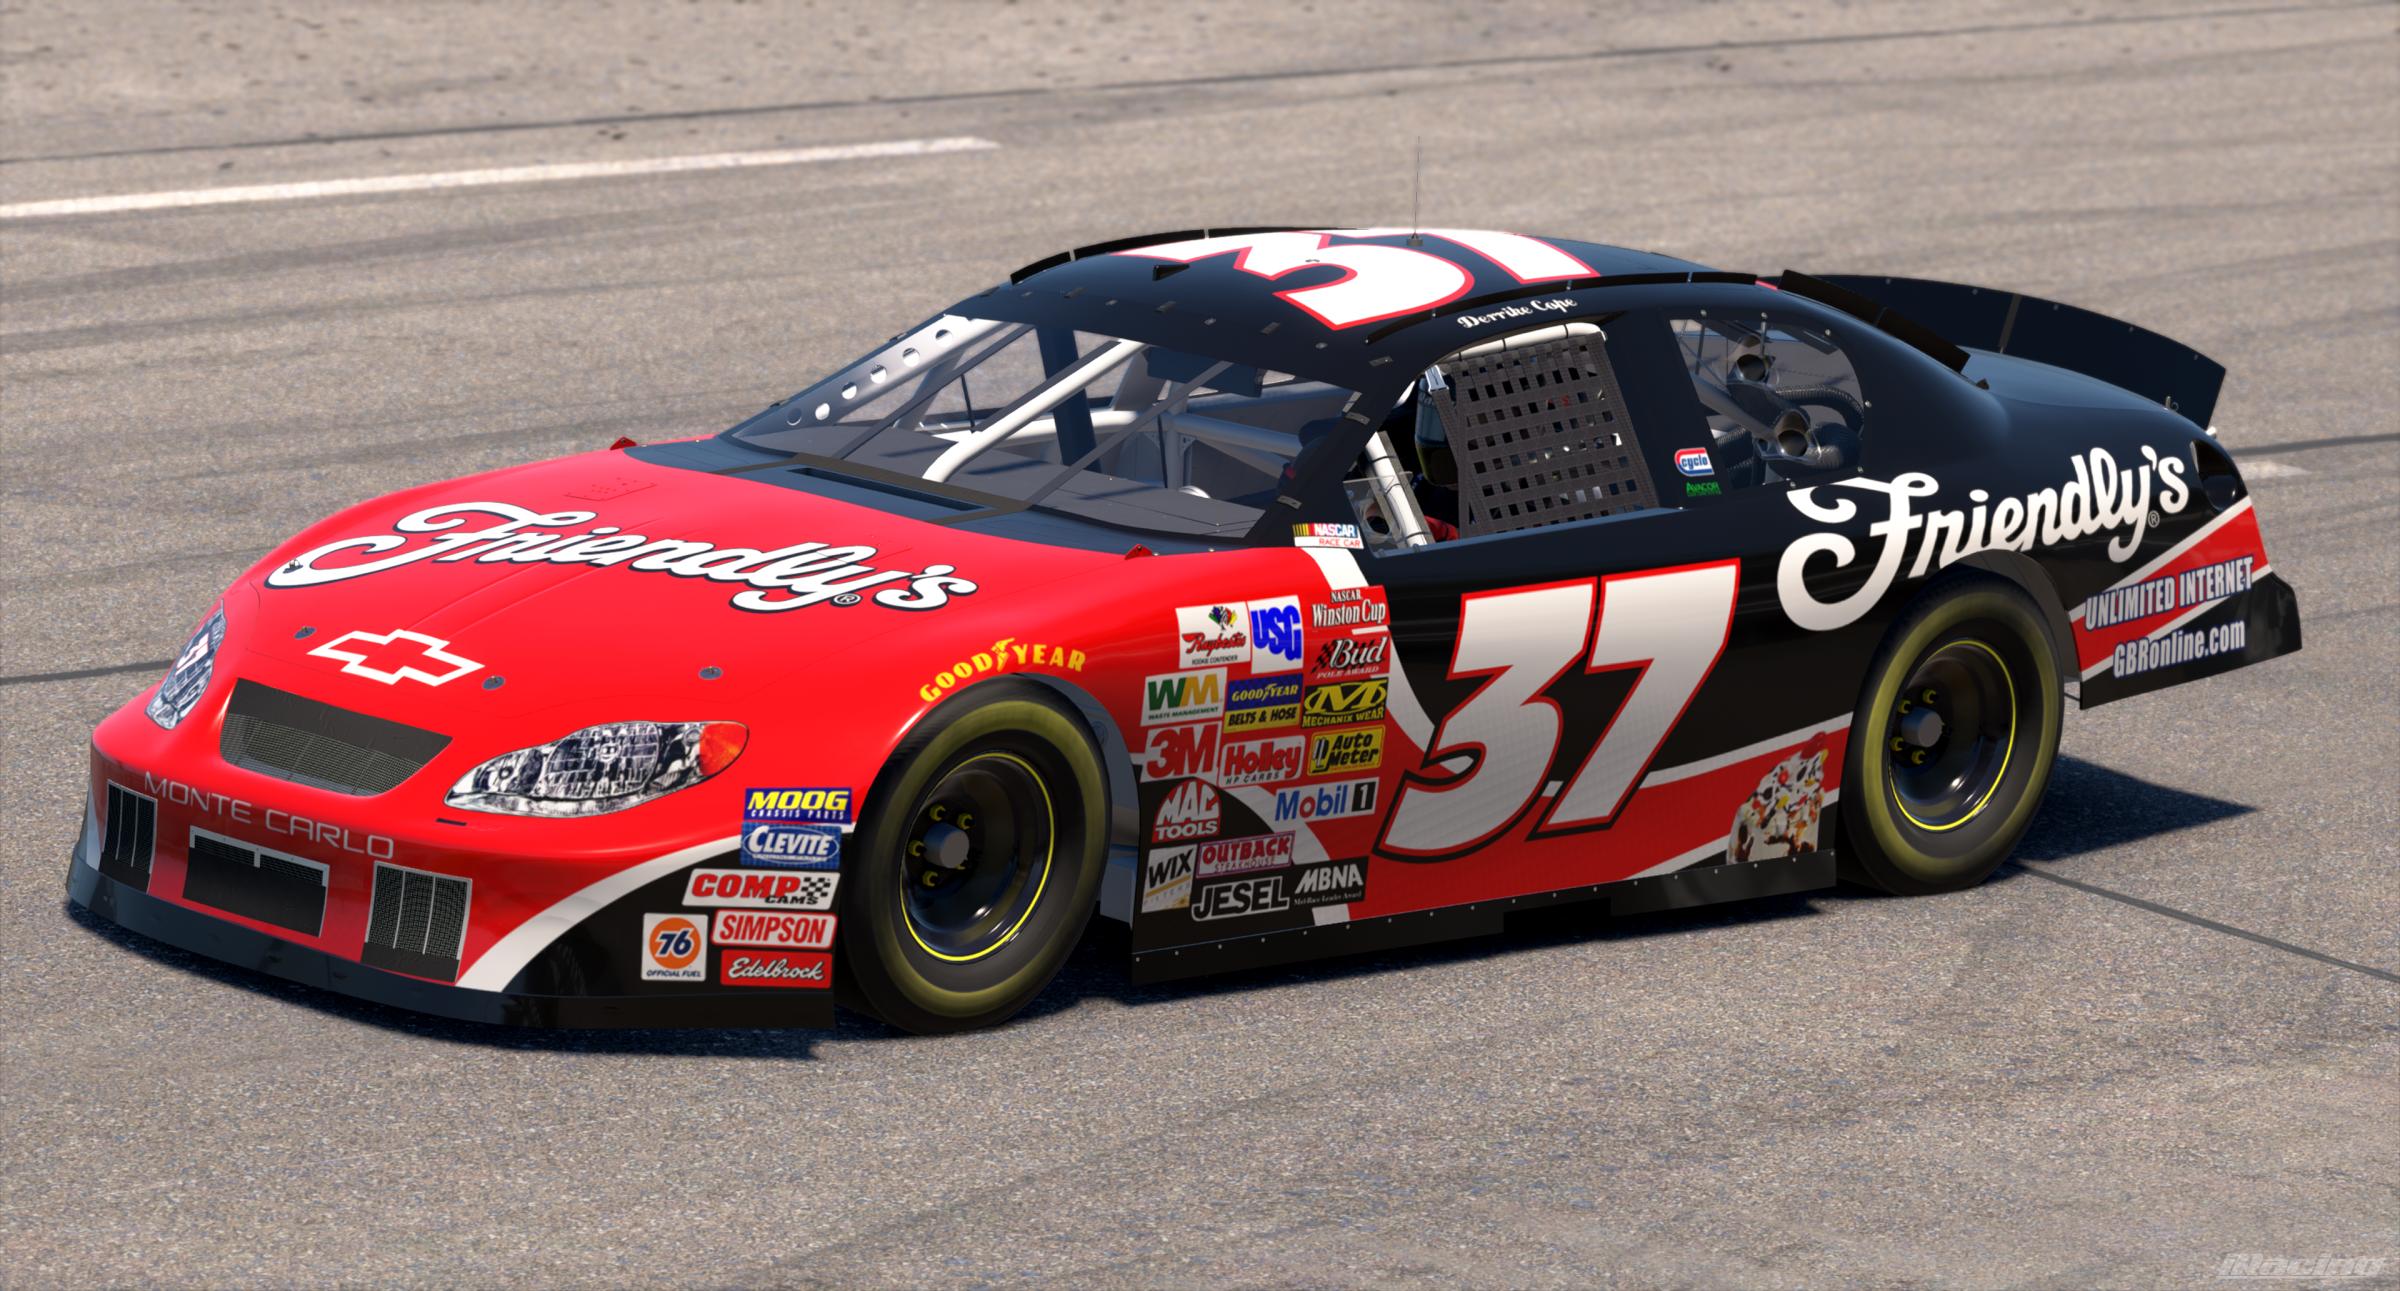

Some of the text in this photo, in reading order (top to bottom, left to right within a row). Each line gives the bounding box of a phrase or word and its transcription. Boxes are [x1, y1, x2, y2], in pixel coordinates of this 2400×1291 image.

[1457, 298, 1578, 328] Derrike Cope
[1313, 523, 1356, 537] NASCAR
[1319, 538, 1361, 548] RACE CAR
[1776, 445, 2189, 632] Friendly's
[264, 500, 978, 614] Friendly's
[1330, 589, 1362, 603] NASCAR
[2084, 555, 2254, 631] UNLIMITED INTERNET
[1311, 598, 1387, 628] Winston Cup
[1181, 631, 1247, 657] Raybestos
[1250, 604, 1302, 661] USG
[1329, 636, 1388, 669] Bud
[2112, 619, 2247, 679] GBRonline.com
[919, 637, 1087, 703] GOODYEAR
[1316, 665, 1380, 679] POLE AWARD
[1148, 674, 1219, 711] WM
[1231, 683, 1299, 703] GOODYEAR
[1149, 706, 1219, 721] WASTE MANAGEMENT
[1228, 706, 1297, 726] BELTS & HOSE
[1355, 706, 1385, 721] WEAR
[1372, 557, 1742, 865] 37
[1146, 724, 1220, 778] 3M
[1333, 732, 1374, 751] Auto
[1223, 742, 1302, 778] Holley
[1327, 748, 1379, 767] Meter
[1226, 771, 1280, 785] HP CARBS
[145, 771, 395, 860] MONTE CARLO
[747, 790, 849, 812] MOOG
[751, 808, 844, 820] CHASSIS PARTS
[1156, 778, 1220, 826] MAC
[1275, 784, 1349, 821] Mobil
[748, 825, 836, 855] CLEVITE
[1155, 819, 1218, 841] TOOLS
[1202, 835, 1291, 866] OUTBACK
[1148, 847, 1194, 889] WIX
[1294, 863, 1364, 895] MBNA
[691, 873, 801, 899] COMP
[764, 895, 819, 906] CAMS
[1191, 875, 1291, 922] JESEL
[655, 926, 696, 959] 76
[719, 914, 828, 944] SIMPSON
[646, 968, 701, 978] OFFICIAL FUEL
[727, 957, 824, 981] Edelbrock
